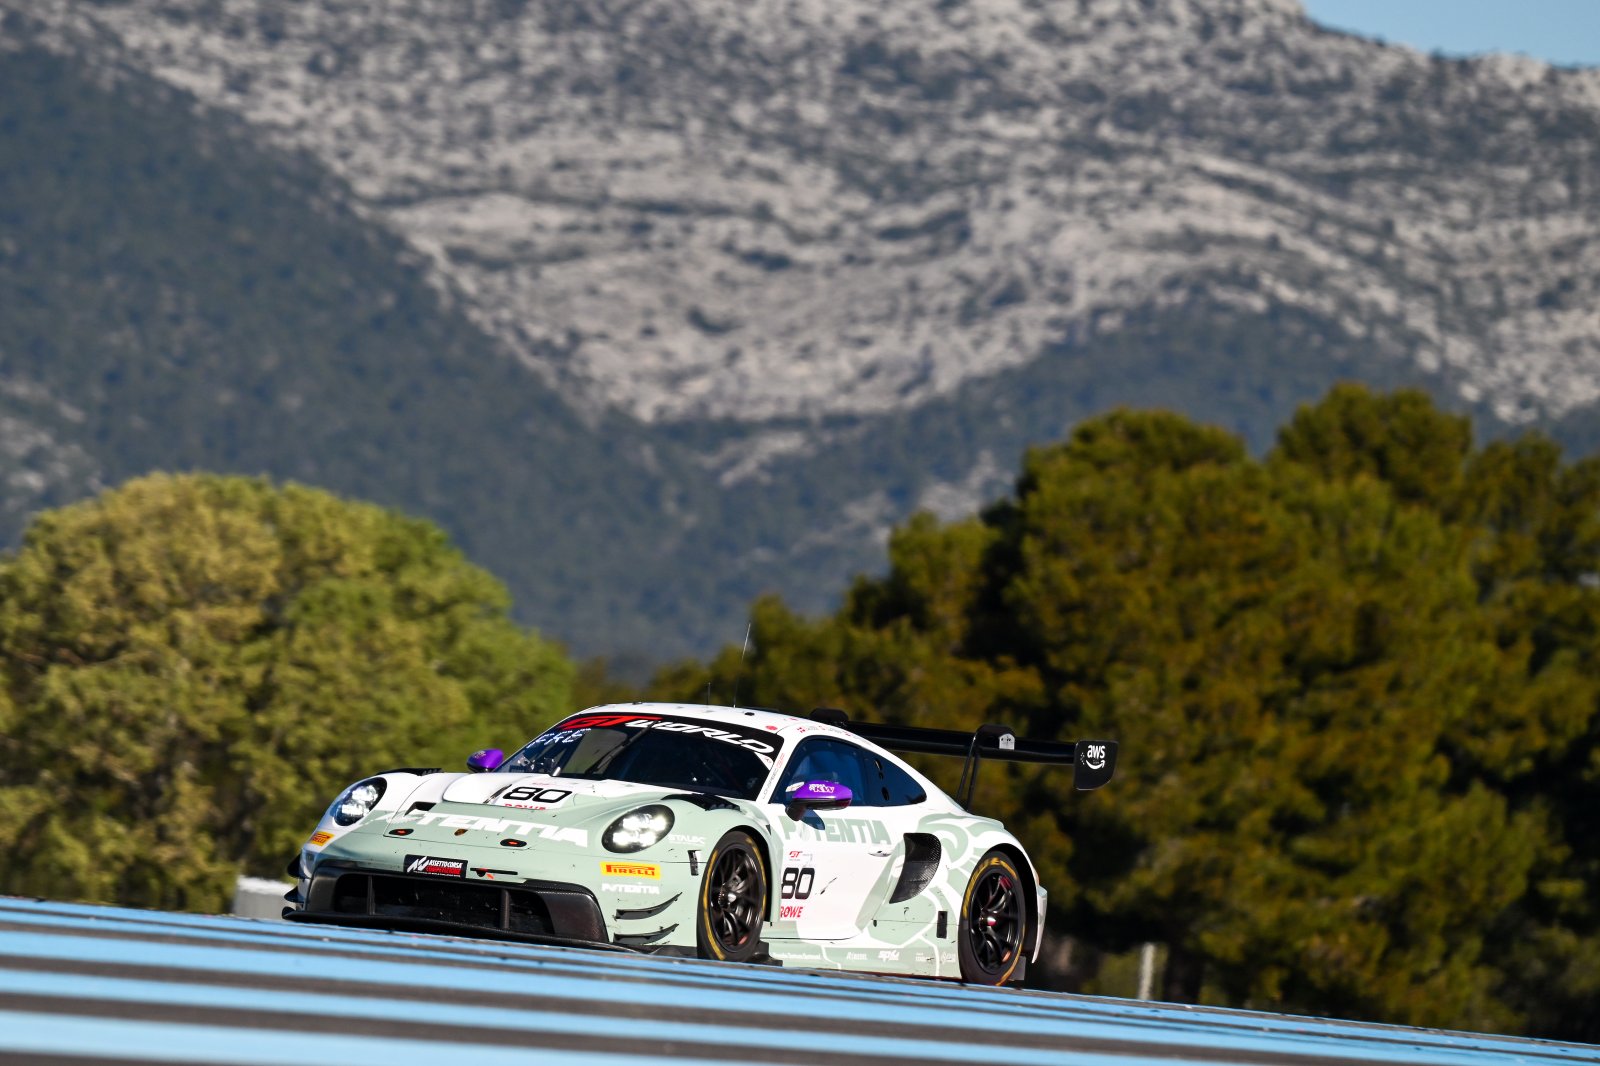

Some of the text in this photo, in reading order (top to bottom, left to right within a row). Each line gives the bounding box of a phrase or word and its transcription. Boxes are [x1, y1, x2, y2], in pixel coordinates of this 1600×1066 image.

[557, 715, 774, 753] GT WORLD
[1086, 744, 1106, 759] aws
[502, 785, 573, 804] 80
[388, 810, 589, 848] TENTIA
[778, 815, 892, 845] PTENTIA
[605, 864, 655, 876] PIRELLI
[780, 866, 815, 900] 80
[780, 906, 803, 918] ROWE
